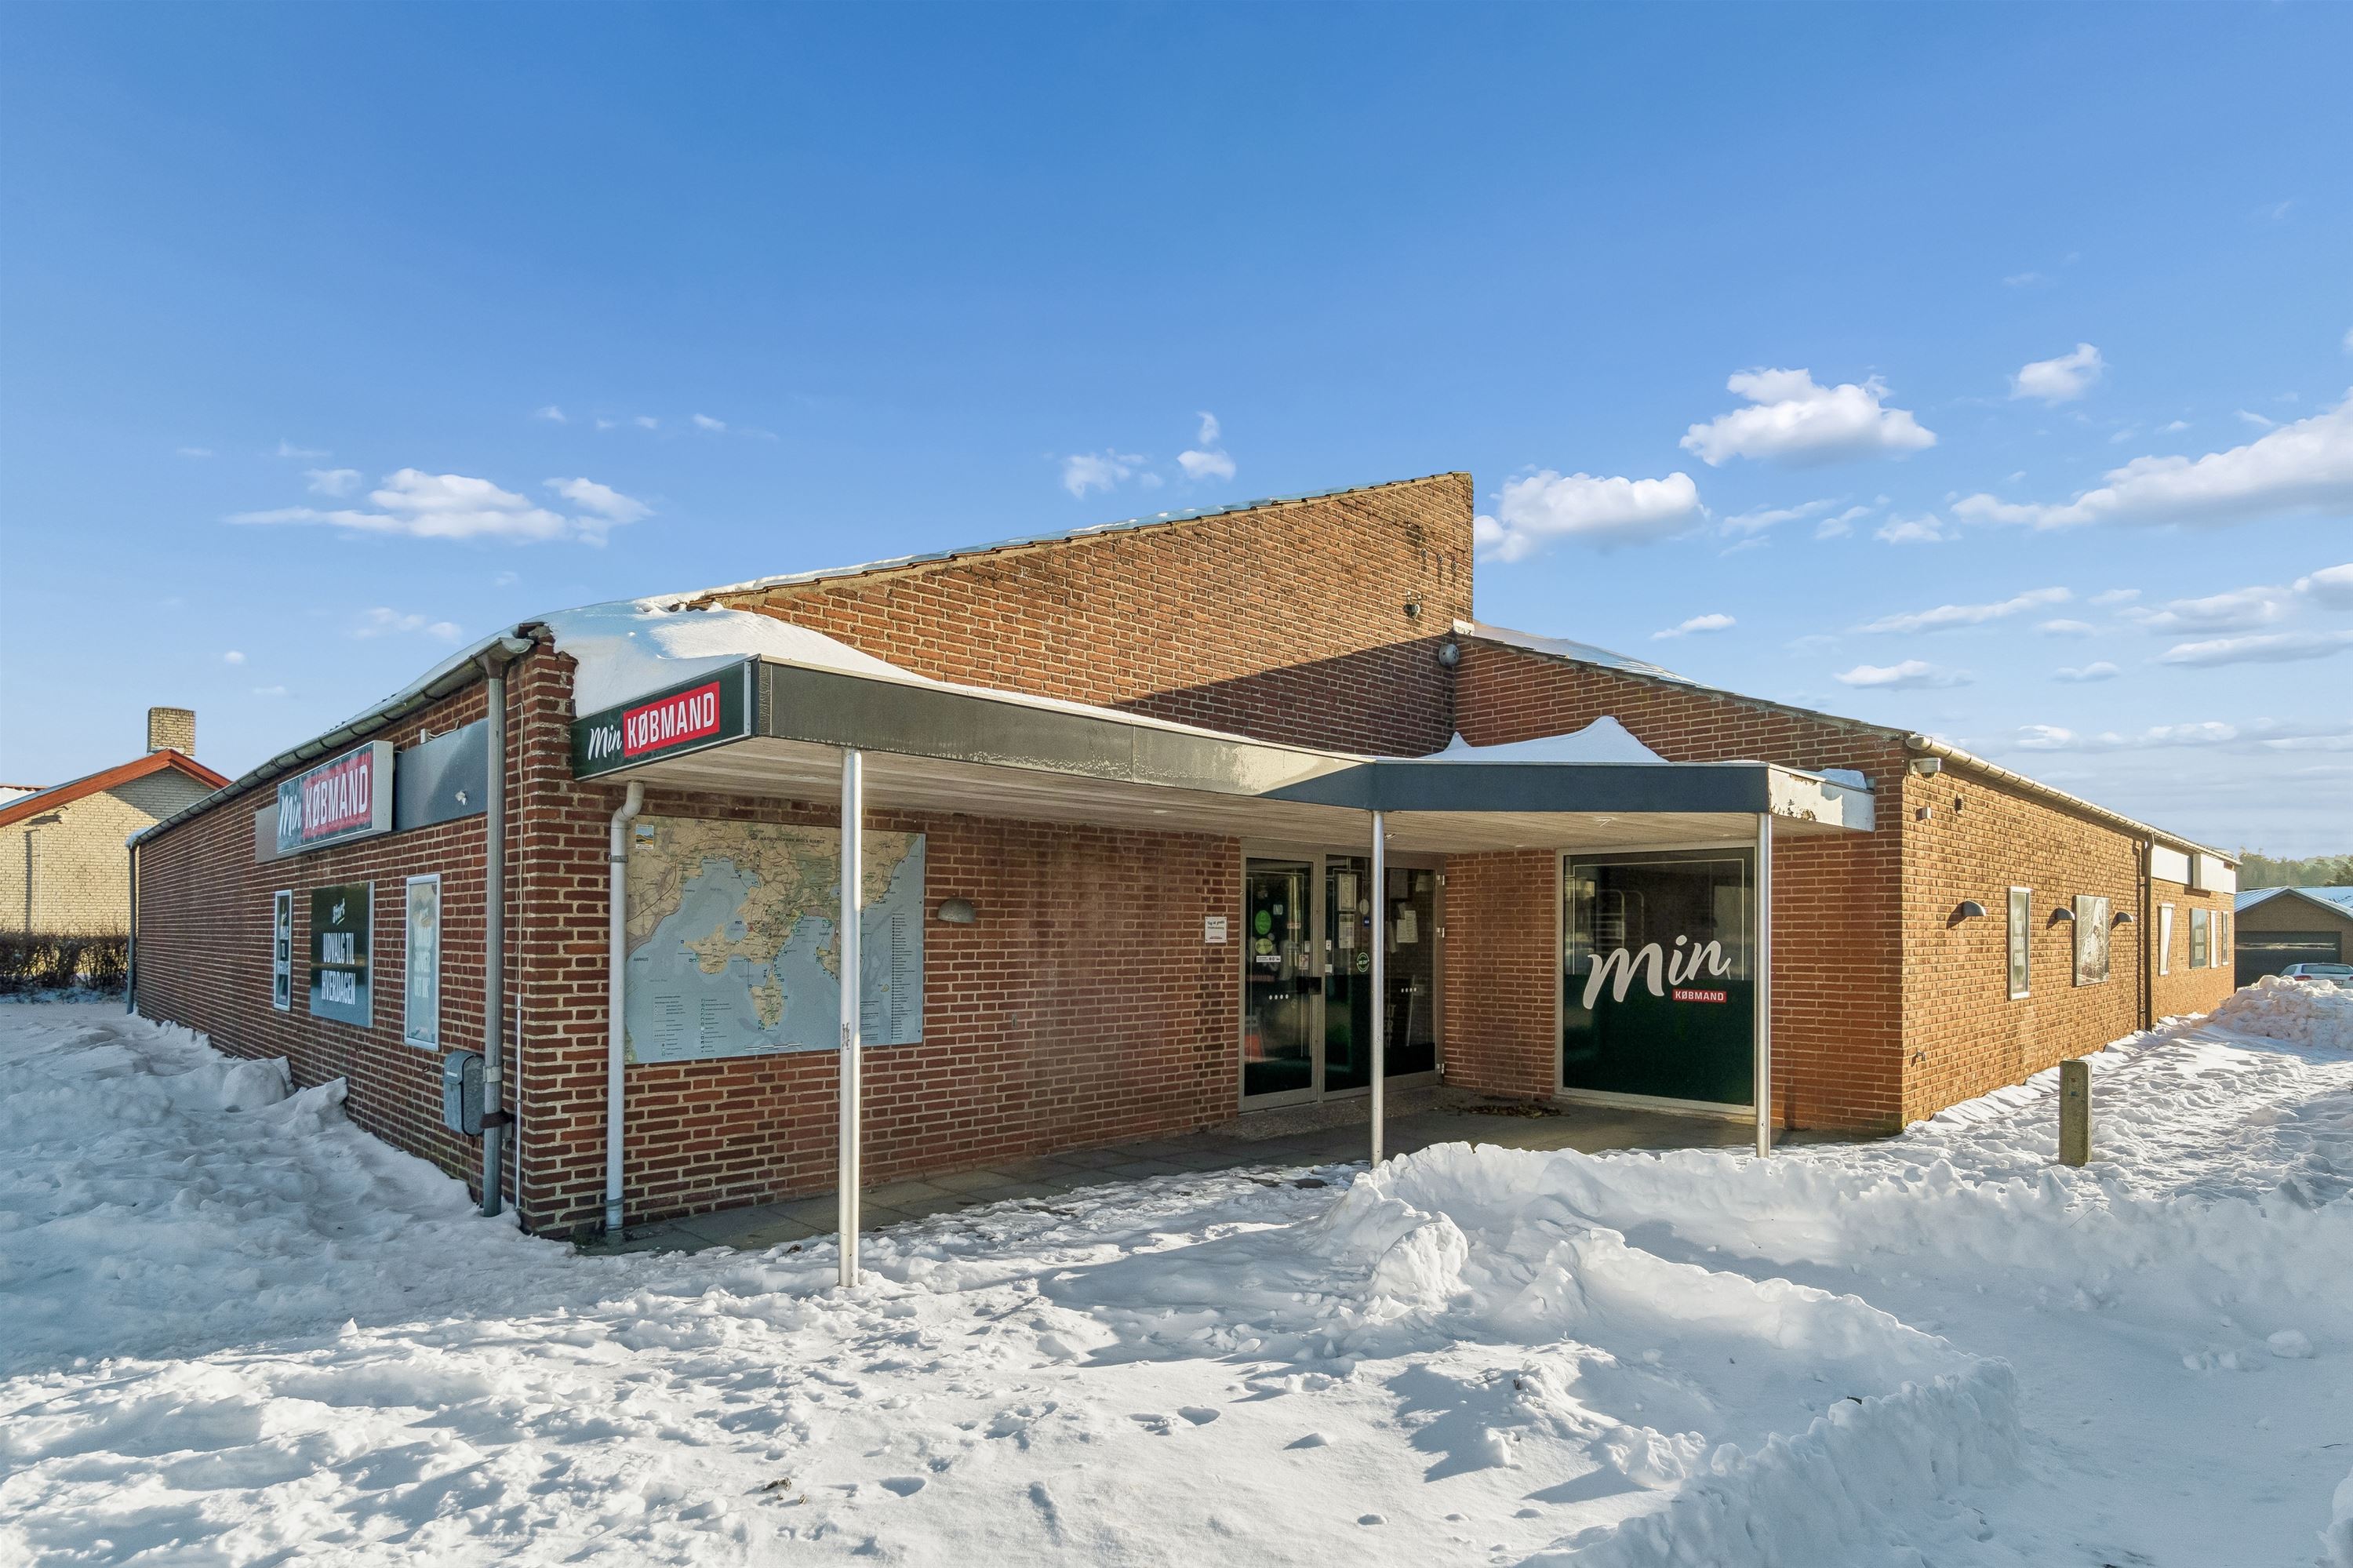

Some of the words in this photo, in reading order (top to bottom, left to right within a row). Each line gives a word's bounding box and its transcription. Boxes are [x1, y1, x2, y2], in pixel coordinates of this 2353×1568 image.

[587, 724, 623, 761] Min
[627, 692, 715, 749] KØBMAND
[278, 794, 303, 837] Min
[305, 764, 369, 831] KØBMAND
[332, 897, 346, 924] Stort
[1273, 904, 1283, 915] IND
[323, 933, 345, 964] UDVALG
[345, 933, 355, 965] TIL
[321, 970, 356, 1006] HVERDAGEN
[1582, 934, 1732, 1010] Min
[1675, 990, 1725, 1002] KØBMAND
